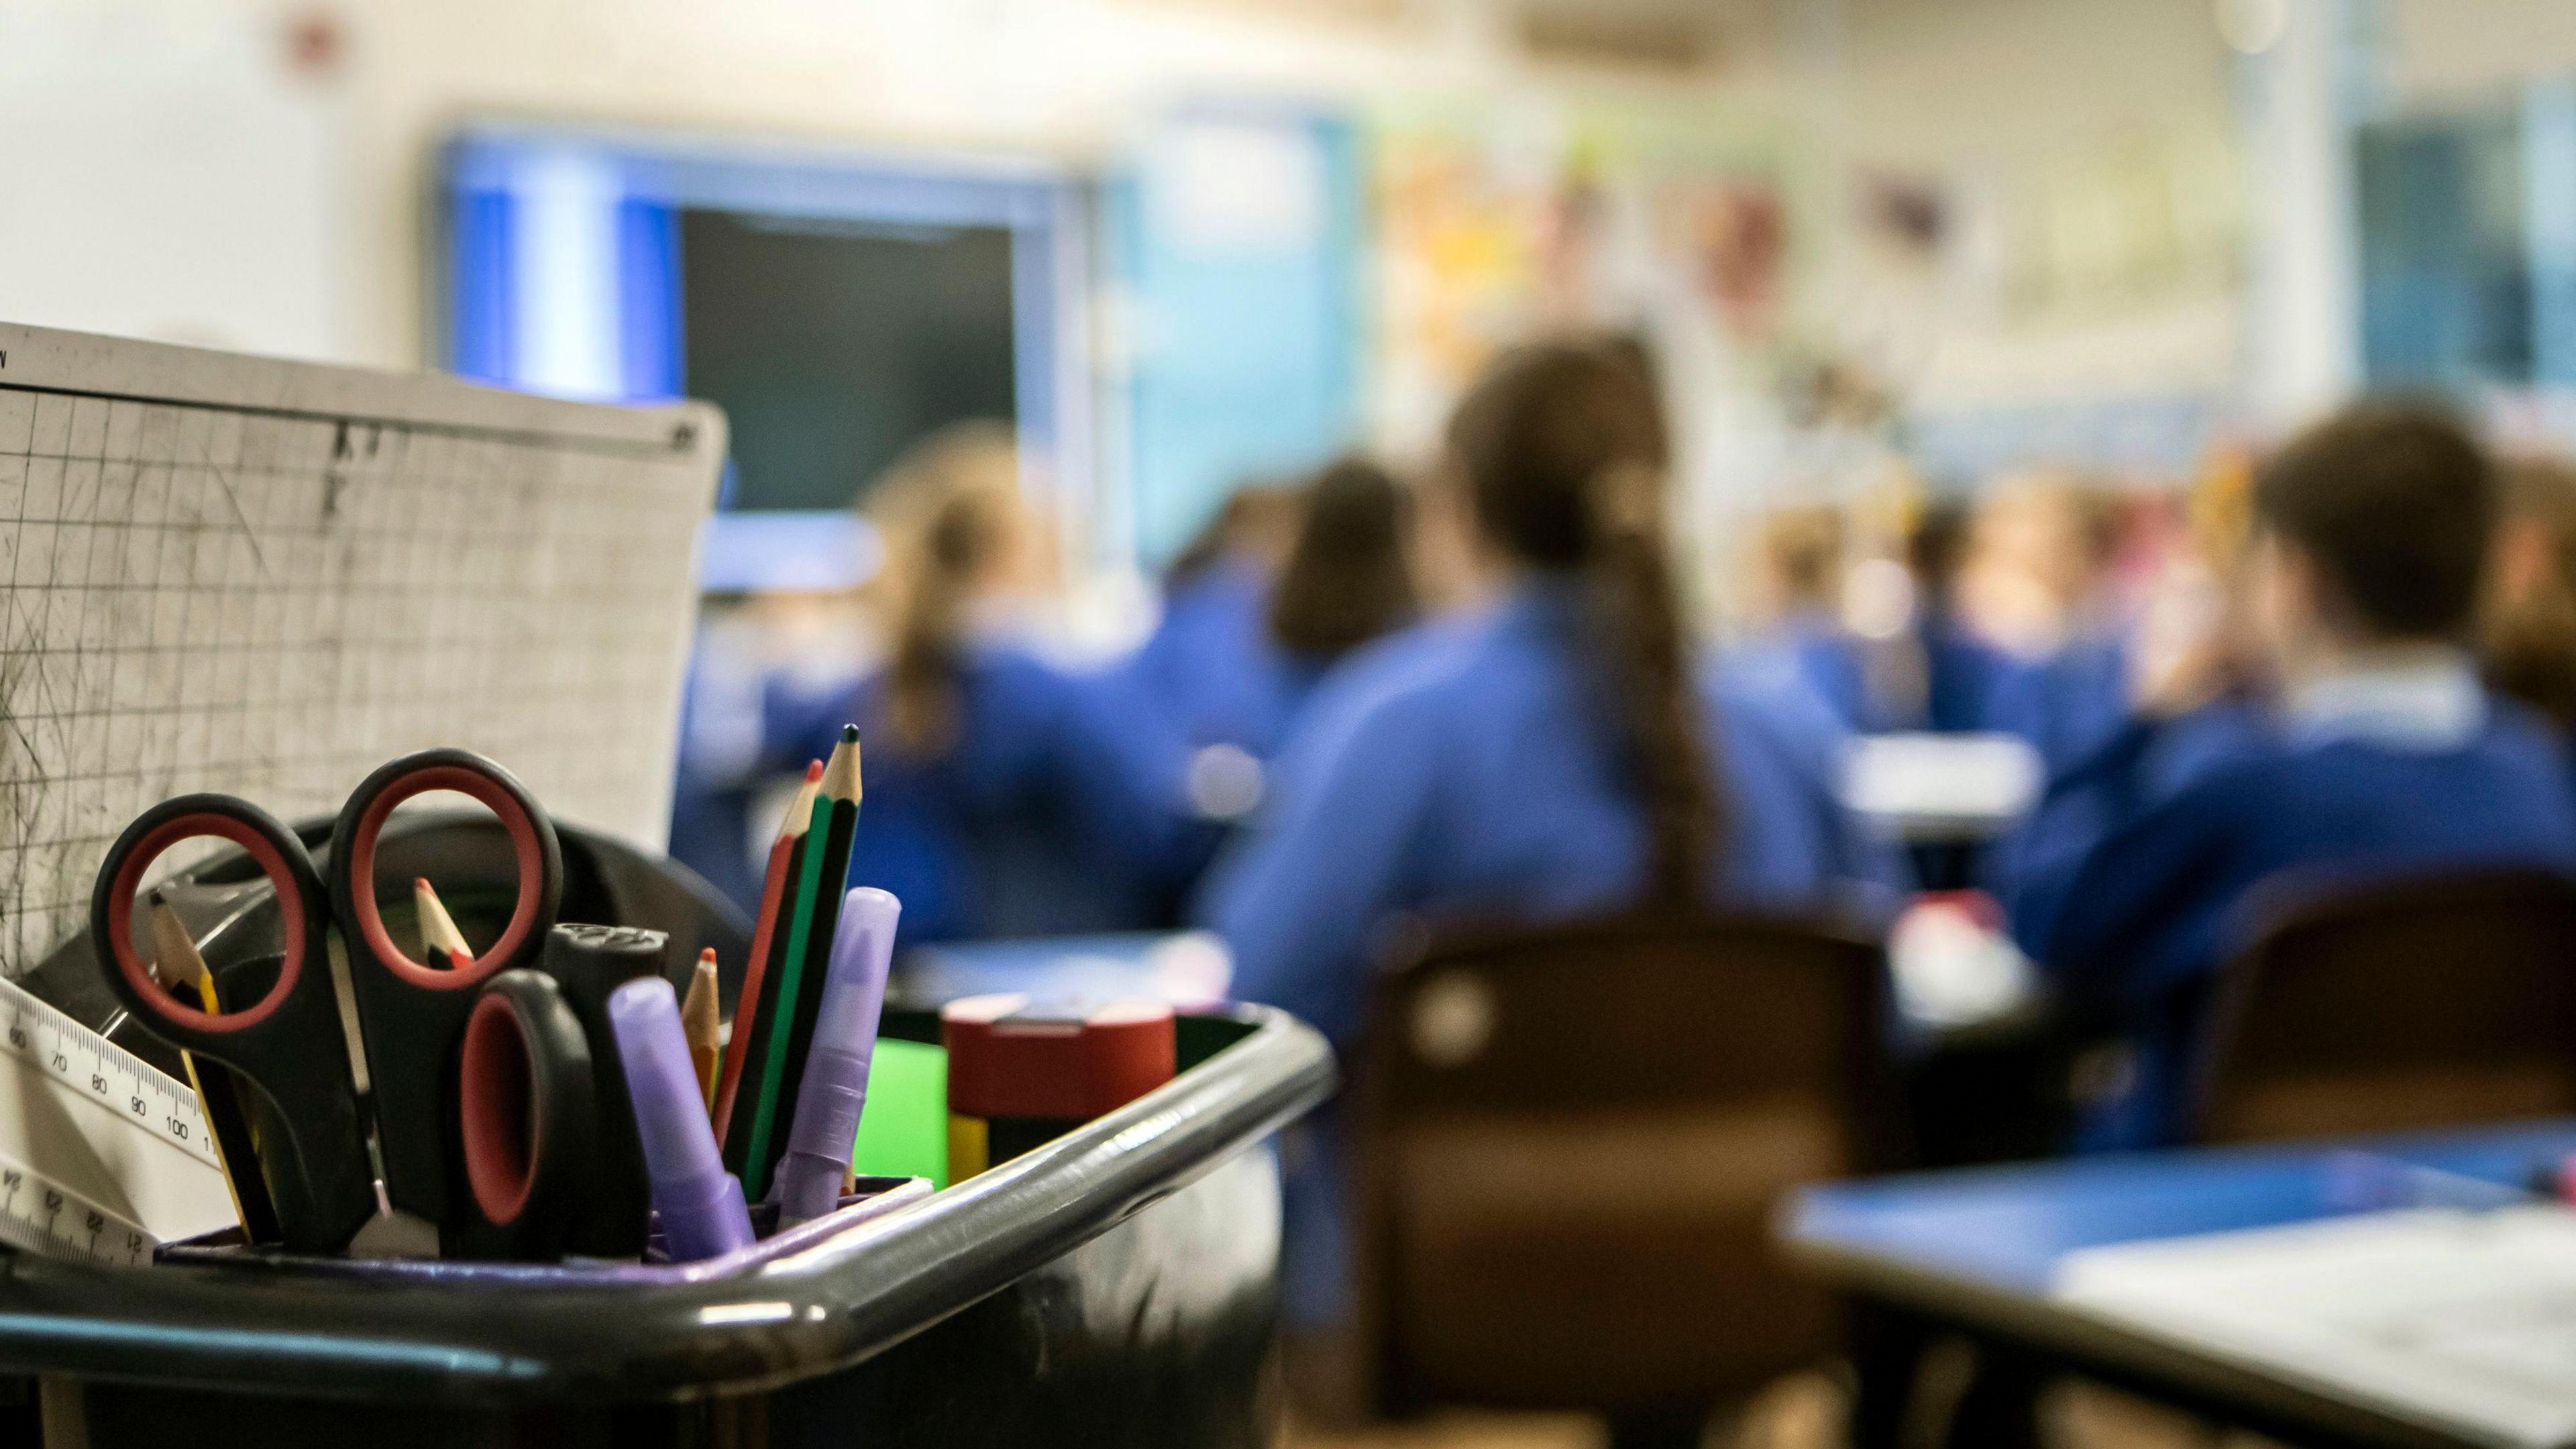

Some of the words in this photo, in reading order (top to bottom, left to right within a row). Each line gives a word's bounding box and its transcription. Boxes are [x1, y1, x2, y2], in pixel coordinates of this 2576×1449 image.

[9, 1027, 26, 1049] 60
[52, 1053, 67, 1072] 70
[92, 1074, 107, 1095] 80
[131, 1095, 146, 1116] 90
[166, 1116, 189, 1139] 100
